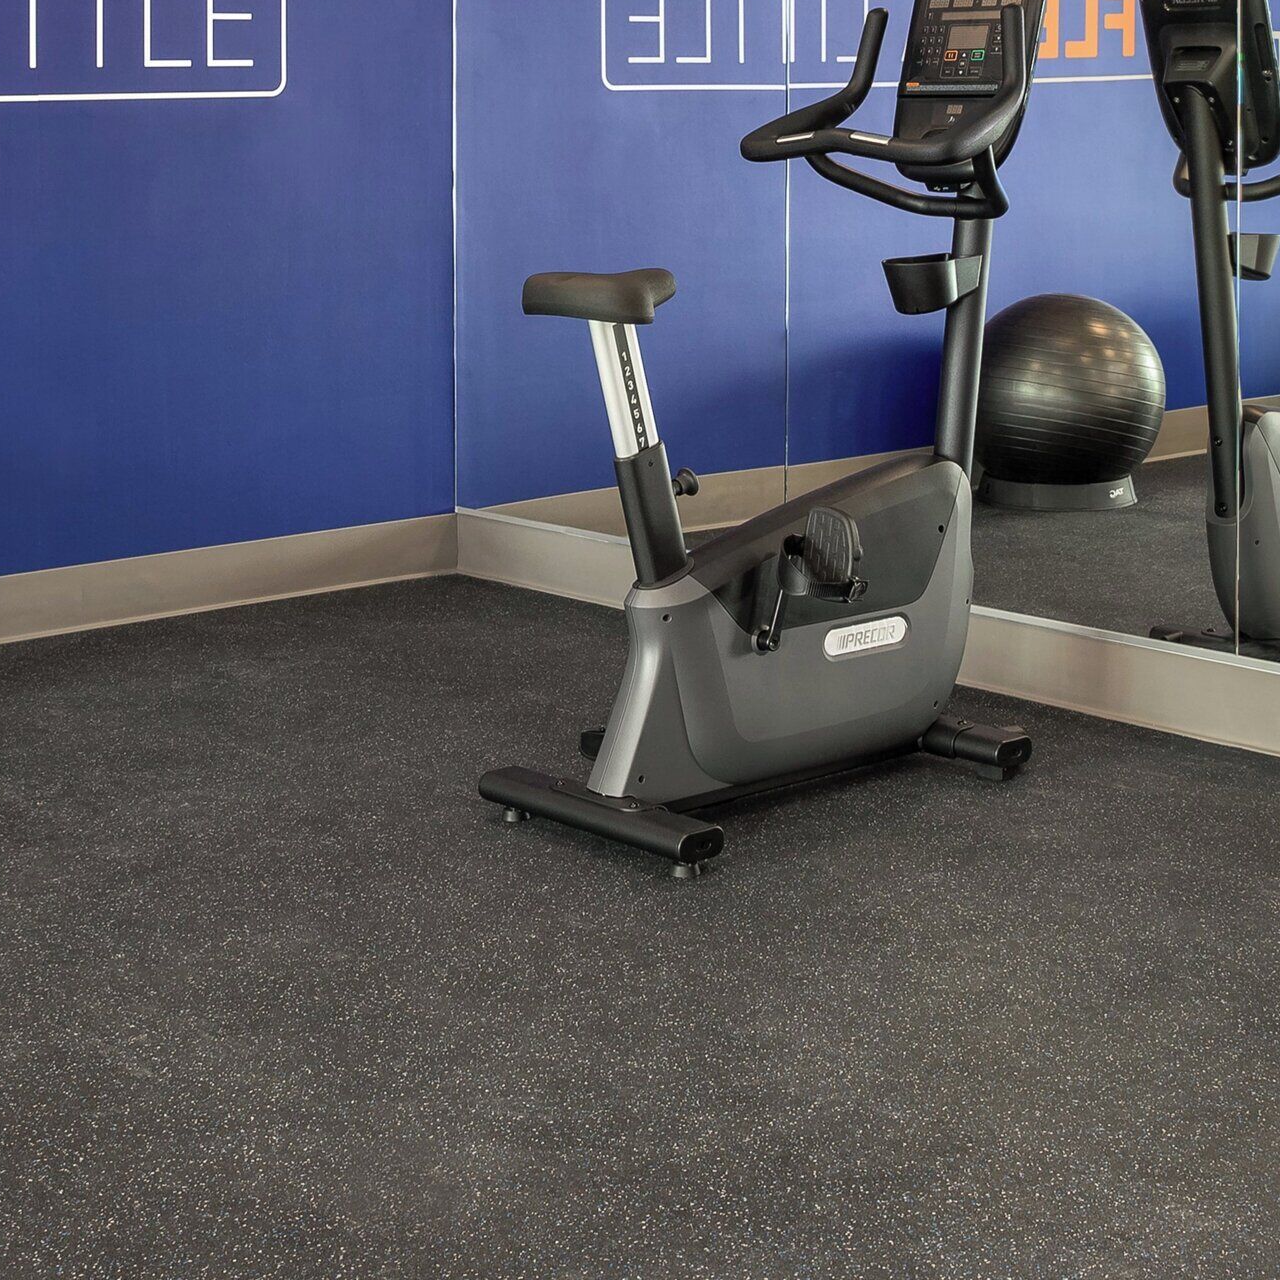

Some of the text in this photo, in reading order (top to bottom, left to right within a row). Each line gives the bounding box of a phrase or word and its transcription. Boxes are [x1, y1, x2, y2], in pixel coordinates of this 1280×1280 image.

[621, 351, 628, 361] 1
[624, 366, 631, 377] 2
[627, 380, 634, 391] 3
[630, 394, 637, 405] 4
[633, 408, 640, 419] 5
[636, 423, 643, 434] 6
[638, 437, 646, 448] 7
[843, 624, 896, 650] PRECOR
